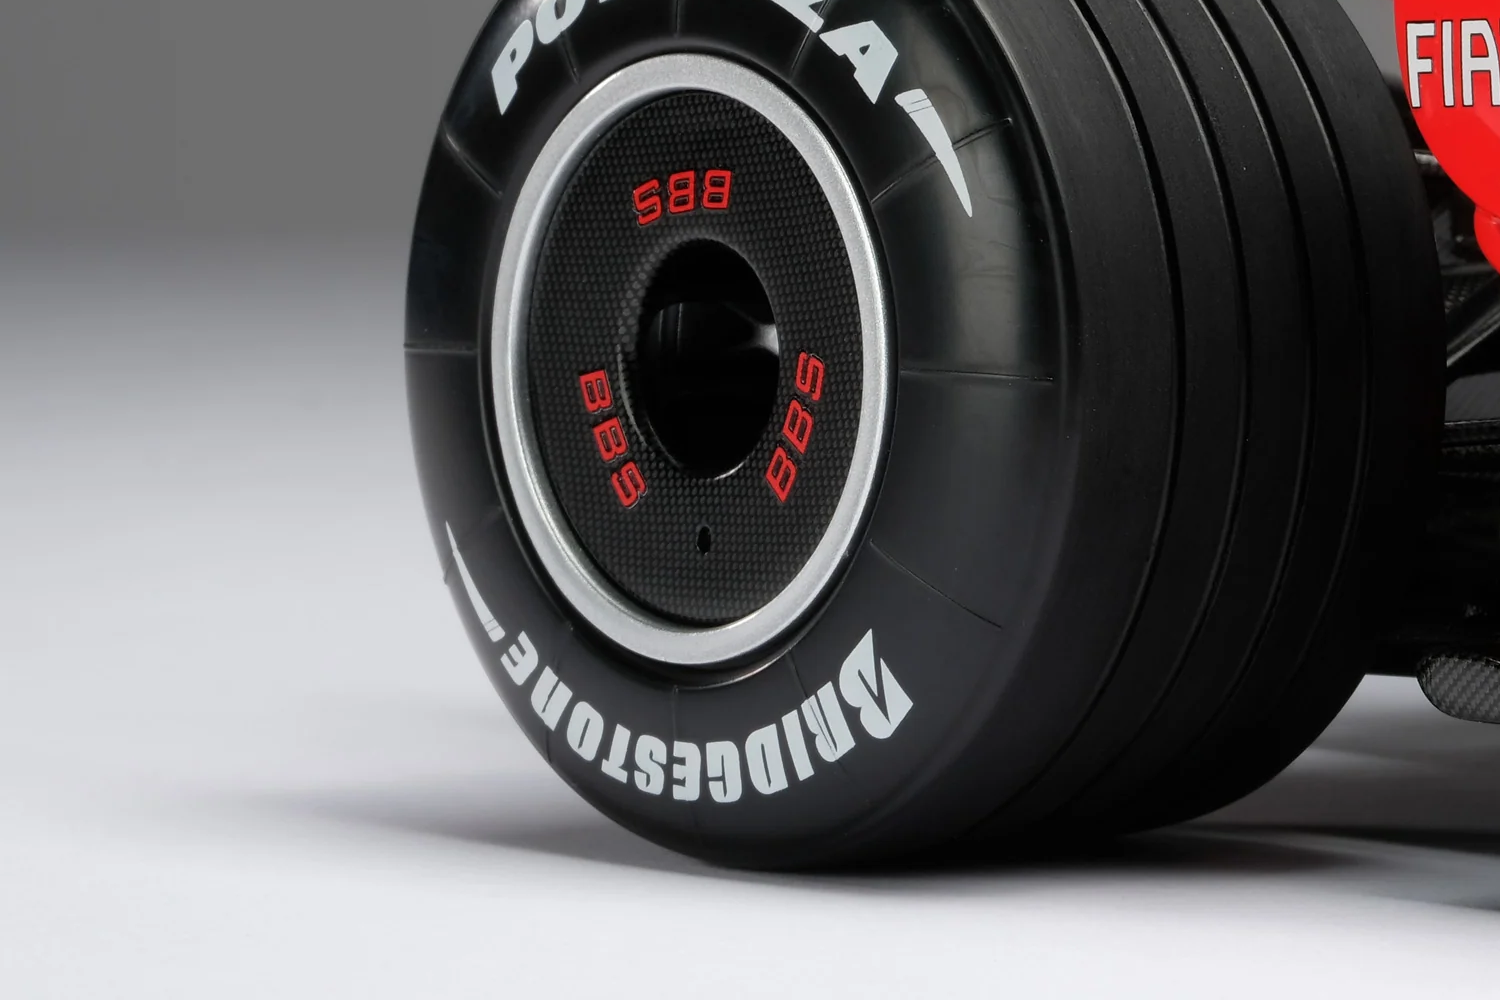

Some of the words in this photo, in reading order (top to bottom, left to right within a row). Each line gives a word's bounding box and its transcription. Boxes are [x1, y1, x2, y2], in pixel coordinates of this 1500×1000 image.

[631, 169, 733, 226] BBS
[578, 369, 648, 508] BBS
[764, 350, 826, 503] BBS
[500, 628, 914, 804] BRIDGESTONE
